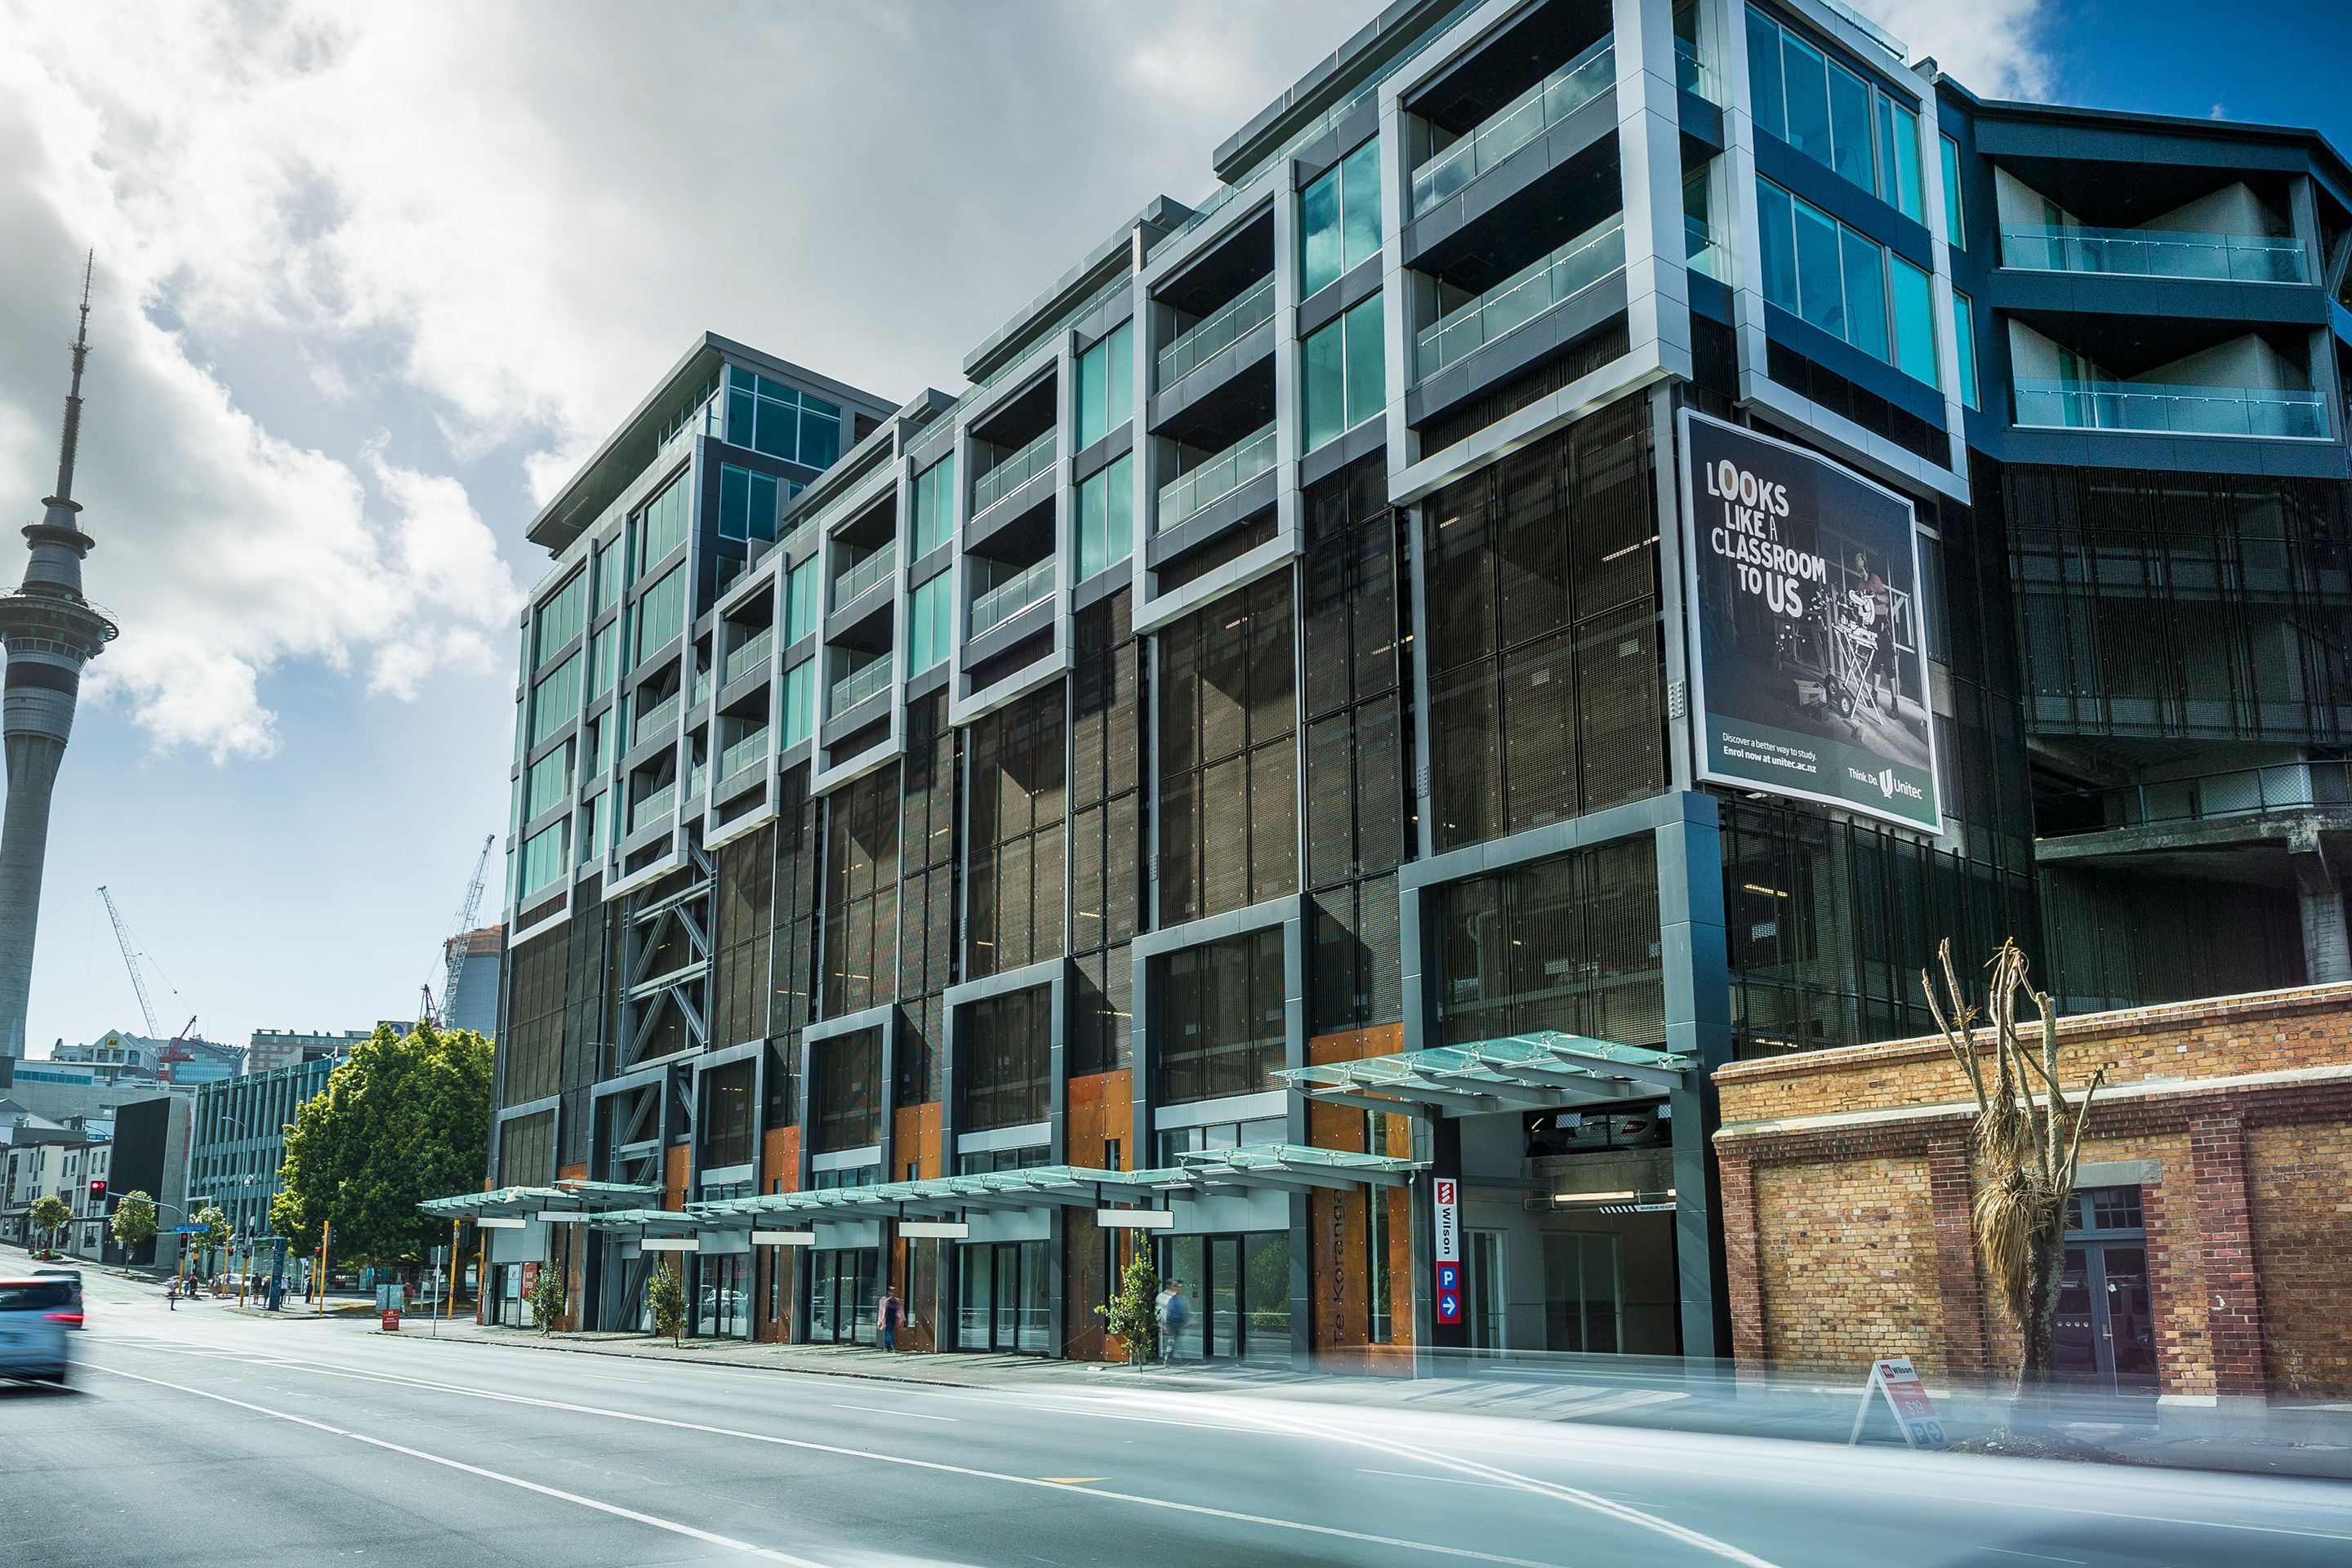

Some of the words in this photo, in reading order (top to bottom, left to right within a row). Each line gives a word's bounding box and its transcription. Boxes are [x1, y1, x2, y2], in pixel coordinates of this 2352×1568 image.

[1706, 459, 1789, 518] LOOKS
[1724, 501, 1766, 539] LIKE
[1769, 514, 1779, 542] A
[1711, 527, 1827, 585] CLASSROOM
[1736, 563, 1762, 595] TO
[1766, 571, 1803, 618] US
[1722, 732, 1750, 746] Discover
[1750, 739, 1756, 747] a
[1755, 739, 1776, 751] better
[1776, 745, 1790, 756] way
[1789, 747, 1797, 756] to
[1797, 749, 1817, 762] study.
[1723, 745, 1744, 759] Enrol
[1744, 751, 1762, 762] now
[1762, 754, 1771, 764] at
[1771, 756, 1817, 773] unitec.ac.nz
[1893, 777, 1922, 800] Unitec
[1441, 1207, 1451, 1255] Wilson
[1334, 1313, 1346, 1349] Te
[1891, 1366, 1913, 1374] Wilson
